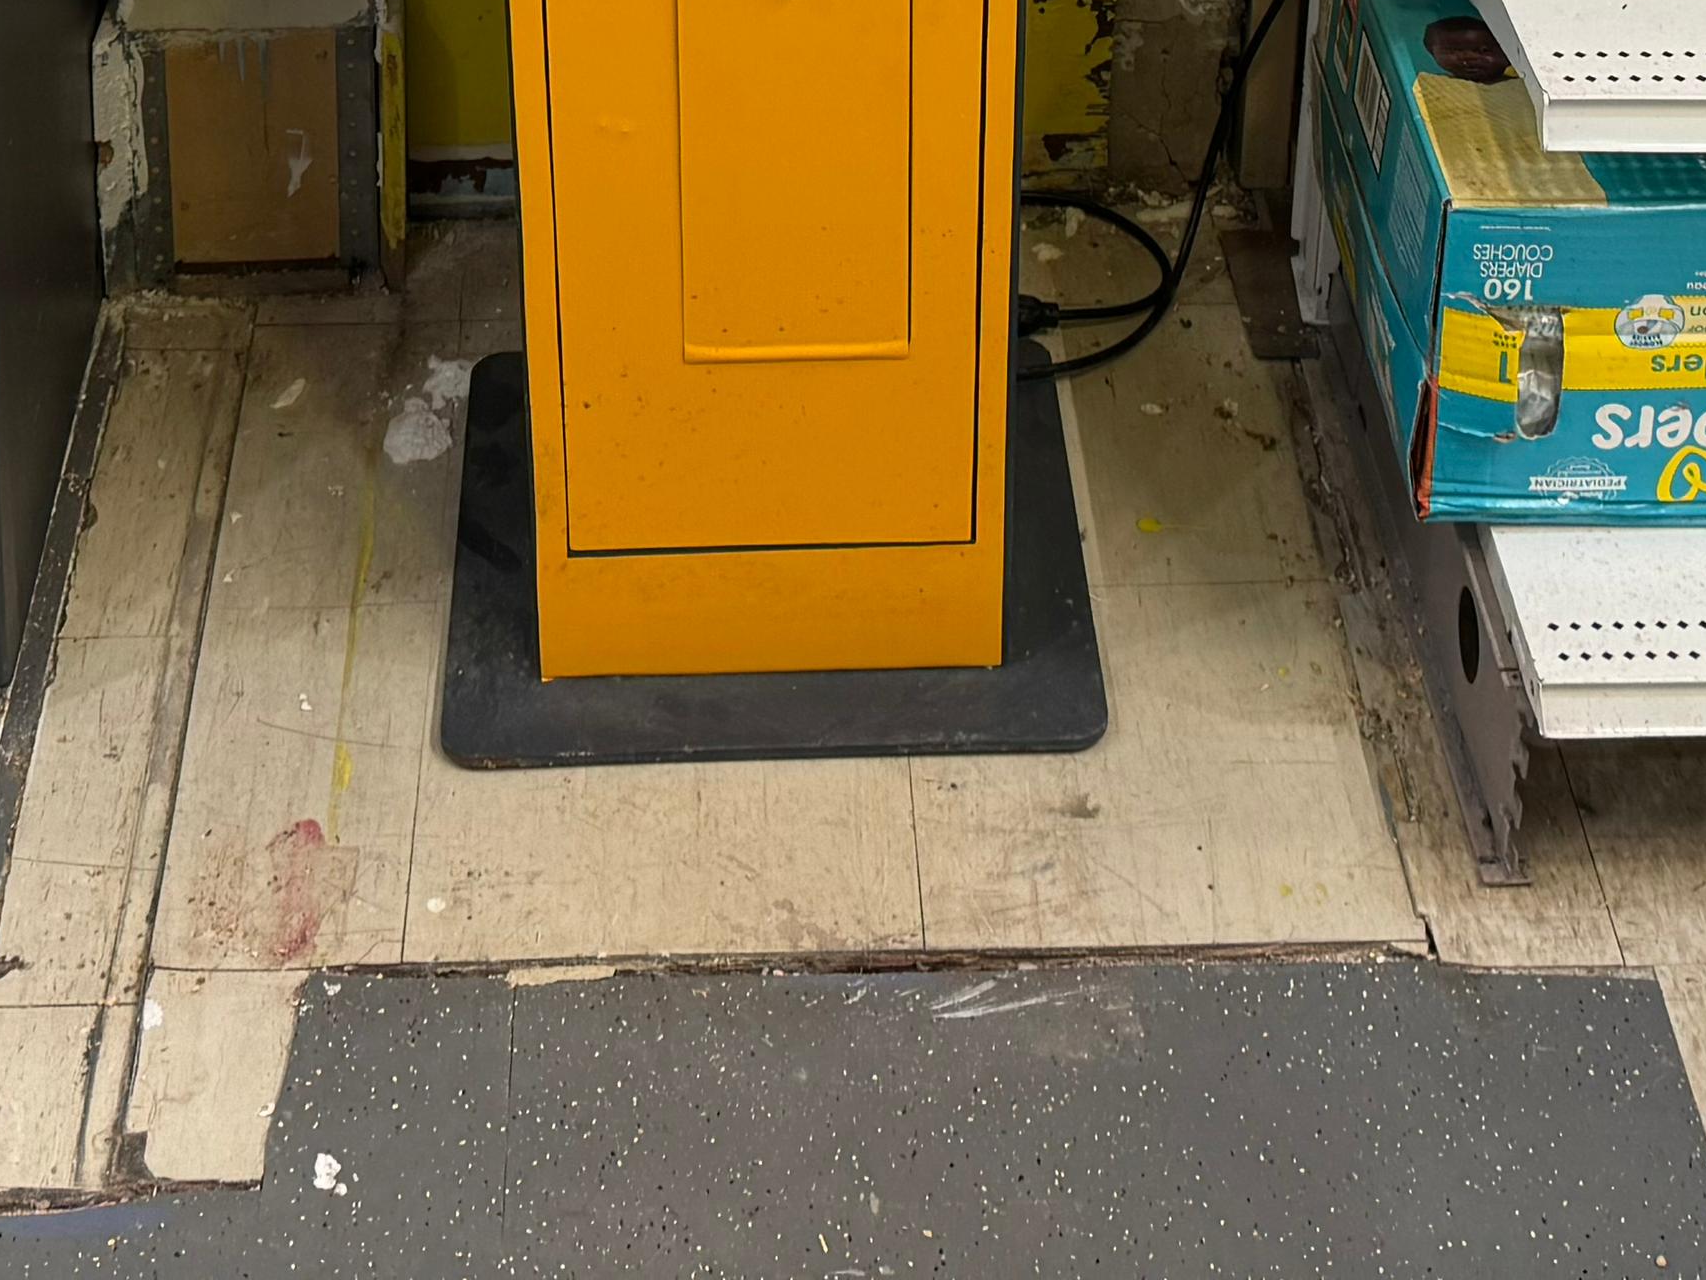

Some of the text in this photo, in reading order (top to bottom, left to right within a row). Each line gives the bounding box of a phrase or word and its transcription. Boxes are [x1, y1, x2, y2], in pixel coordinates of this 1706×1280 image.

[1473, 245, 1552, 261] COUCHES
[1481, 262, 1542, 277] DIAPERS
[1484, 279, 1533, 300] 160
